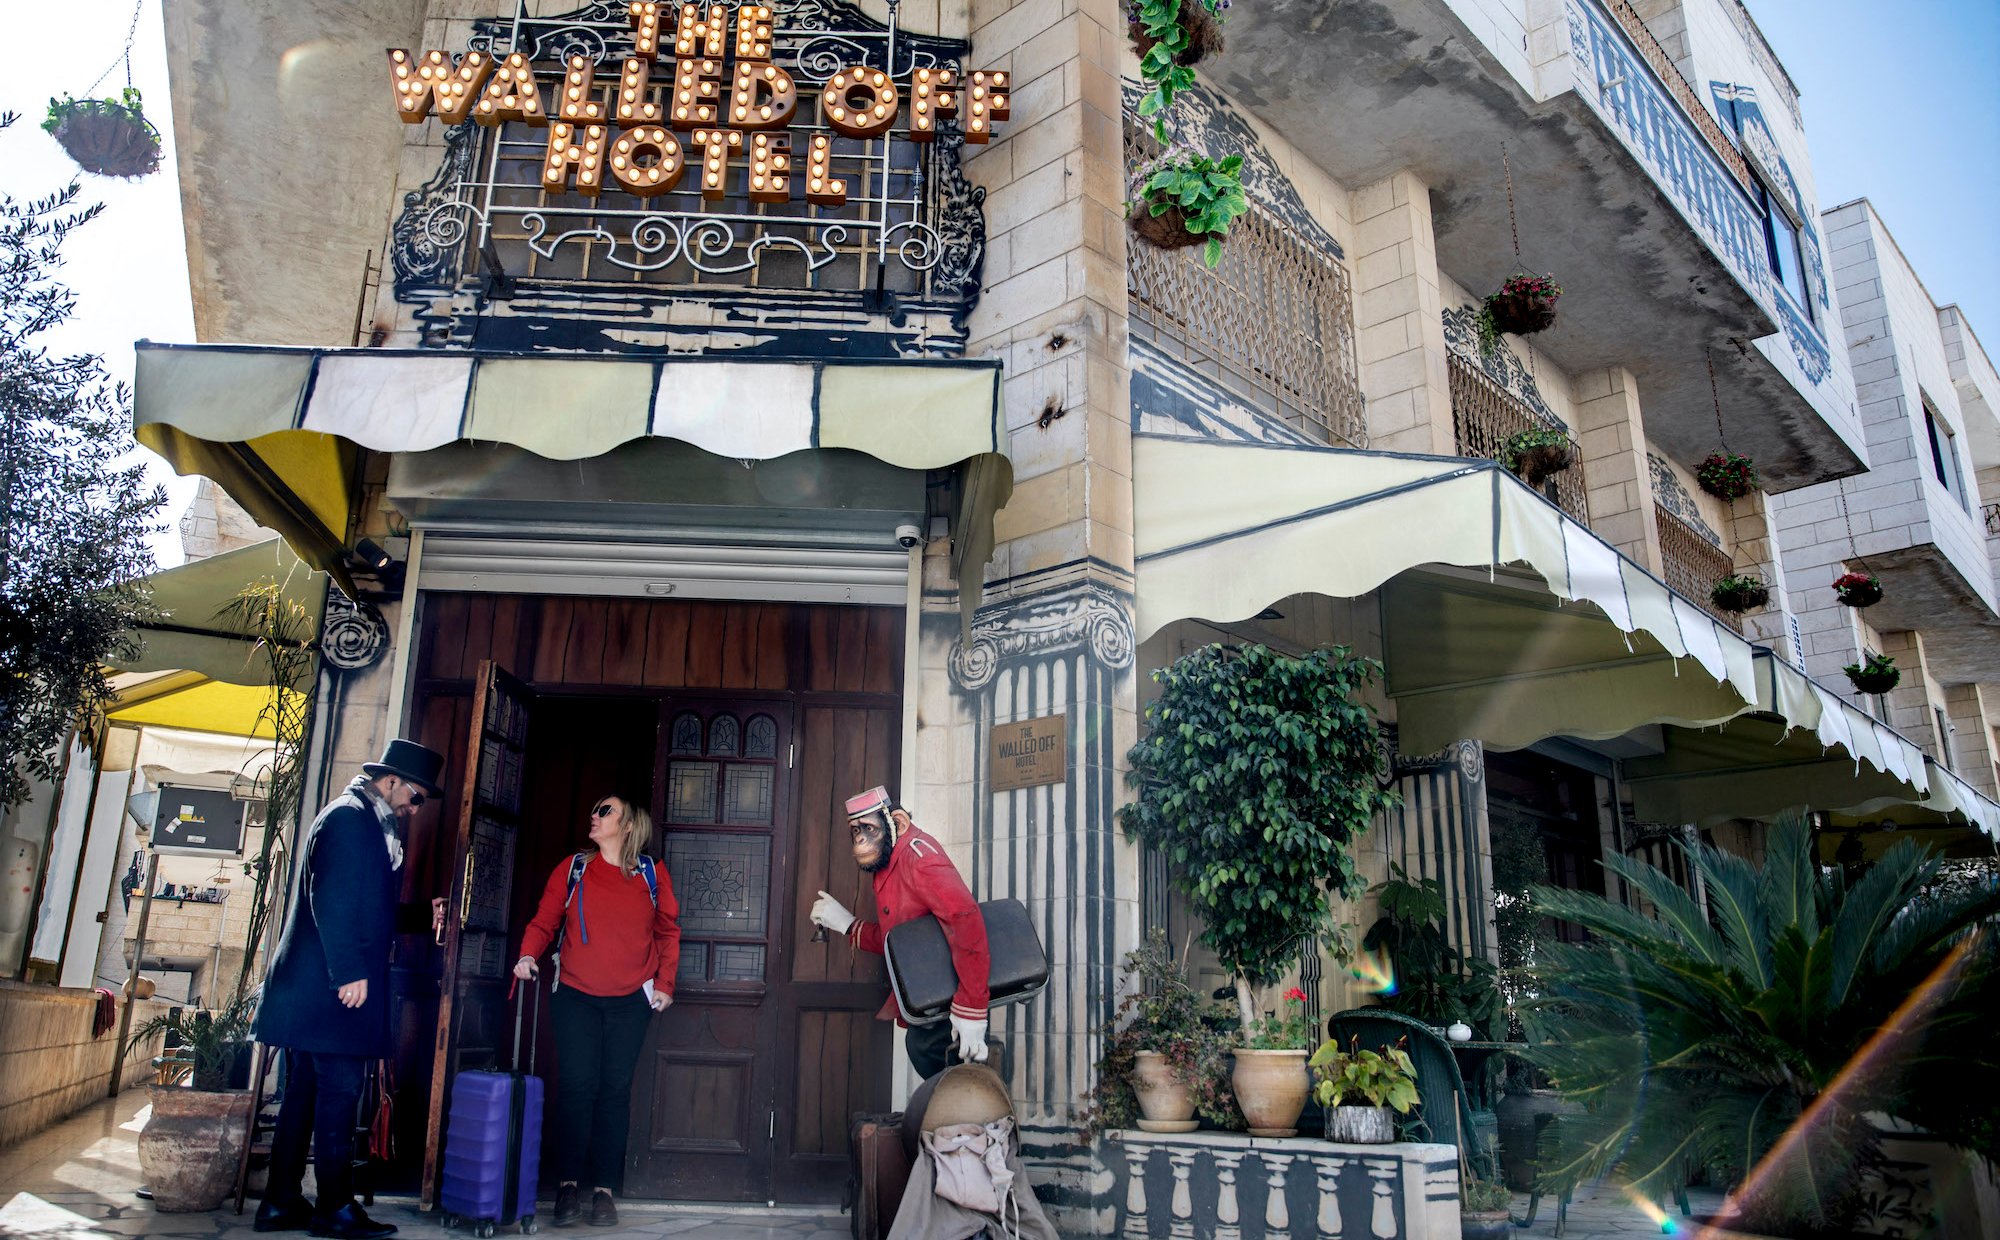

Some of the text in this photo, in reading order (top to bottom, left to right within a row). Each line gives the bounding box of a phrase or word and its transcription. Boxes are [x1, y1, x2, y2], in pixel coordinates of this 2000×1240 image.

[629, 2, 774, 62] THE
[385, 48, 1011, 144] WALLED OFF
[542, 124, 847, 206] HOTEL
[998, 735, 1056, 759] WALLED OFF
[1020, 727, 1032, 738] THE
[1015, 755, 1037, 768] HOTEL
